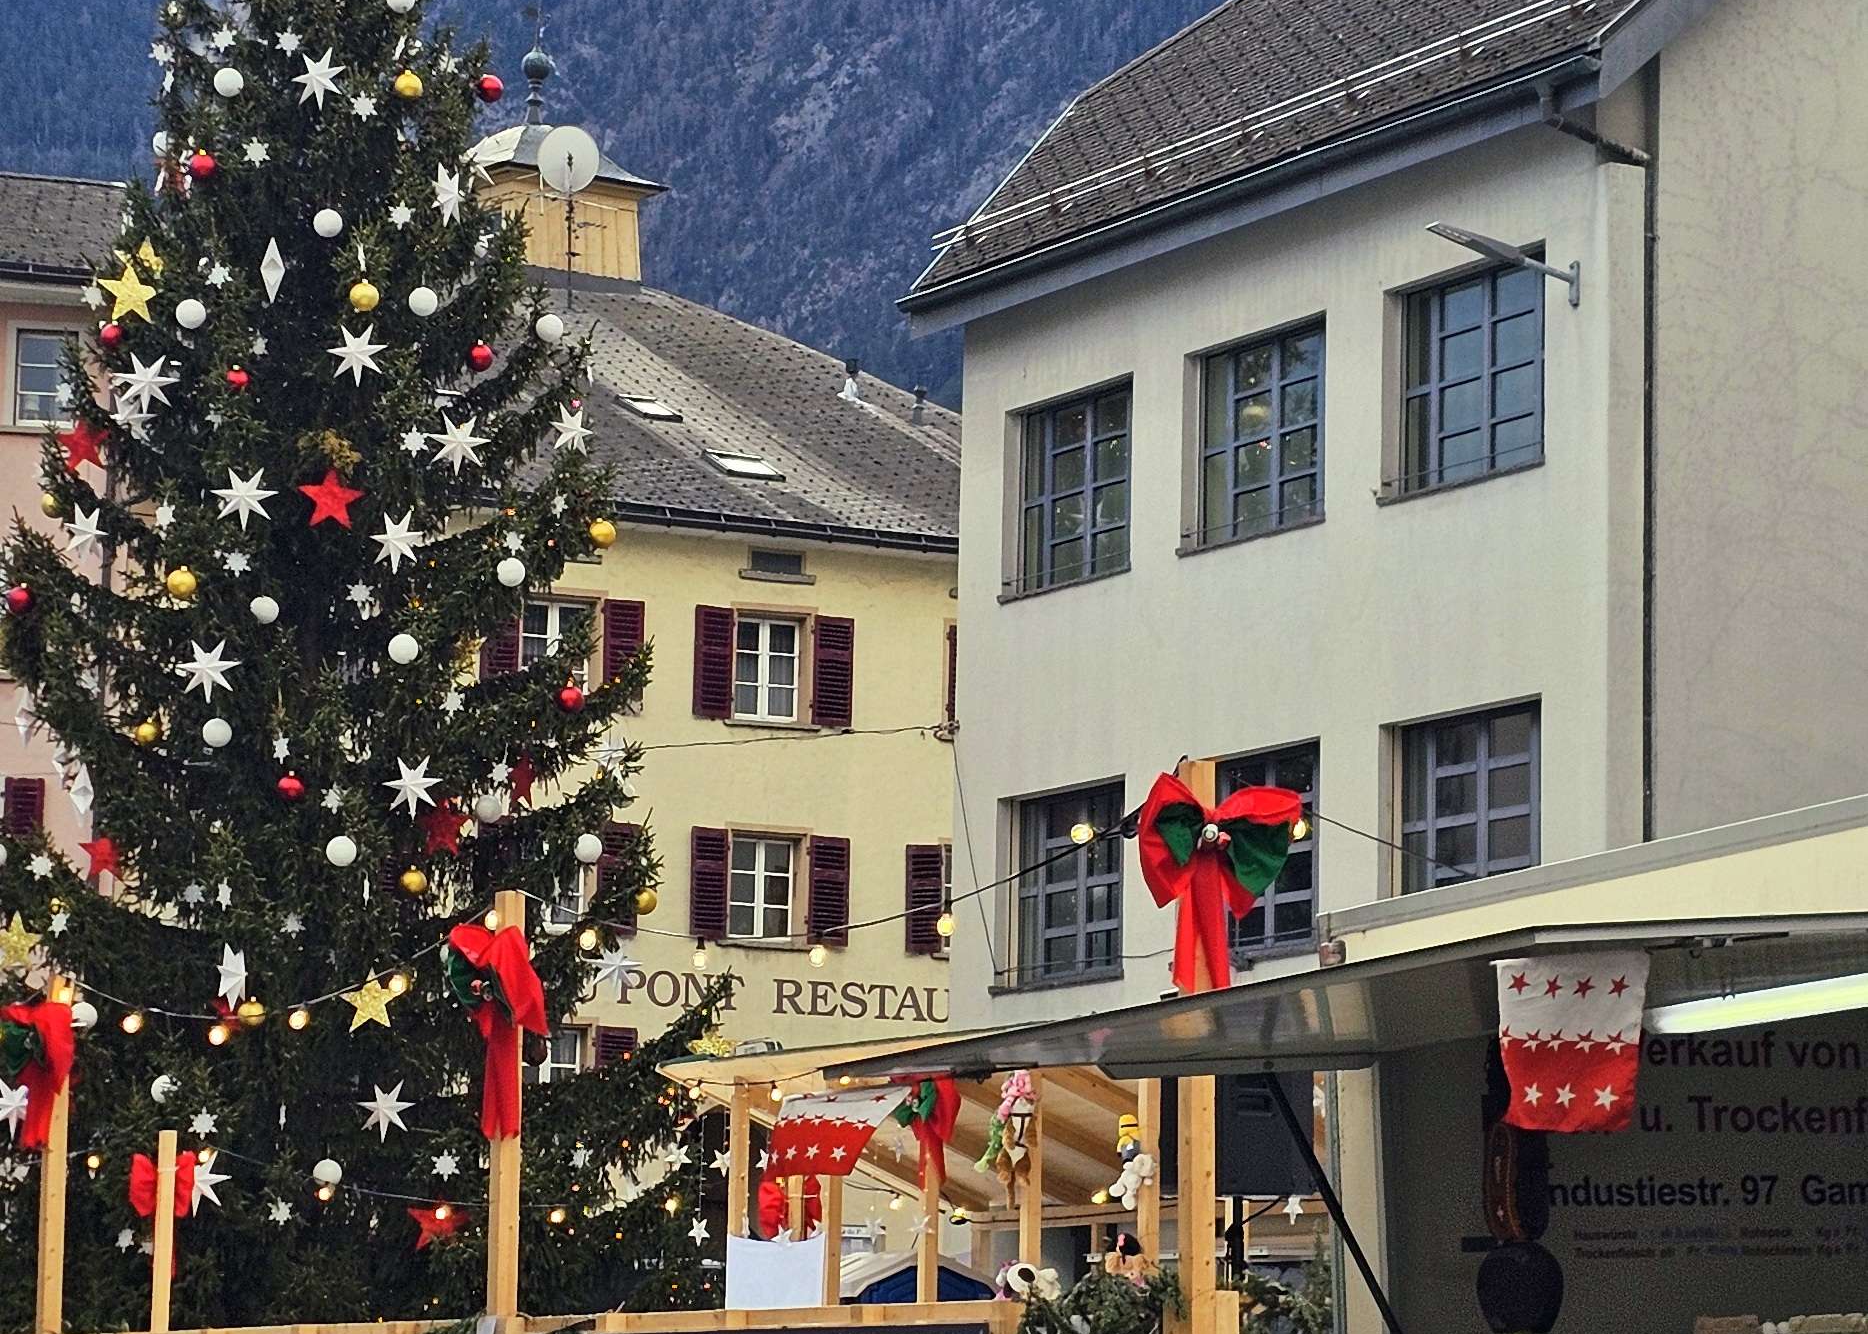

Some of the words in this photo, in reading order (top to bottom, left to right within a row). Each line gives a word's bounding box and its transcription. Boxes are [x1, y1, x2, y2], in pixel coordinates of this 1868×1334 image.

[772, 978, 949, 1023] RESTAU
[1646, 1030, 1776, 1067] erkauf
[1786, 1040, 1860, 1068] von
[1548, 1174, 1730, 1206] ndustiestr.
[1740, 1174, 1779, 1206] 97
